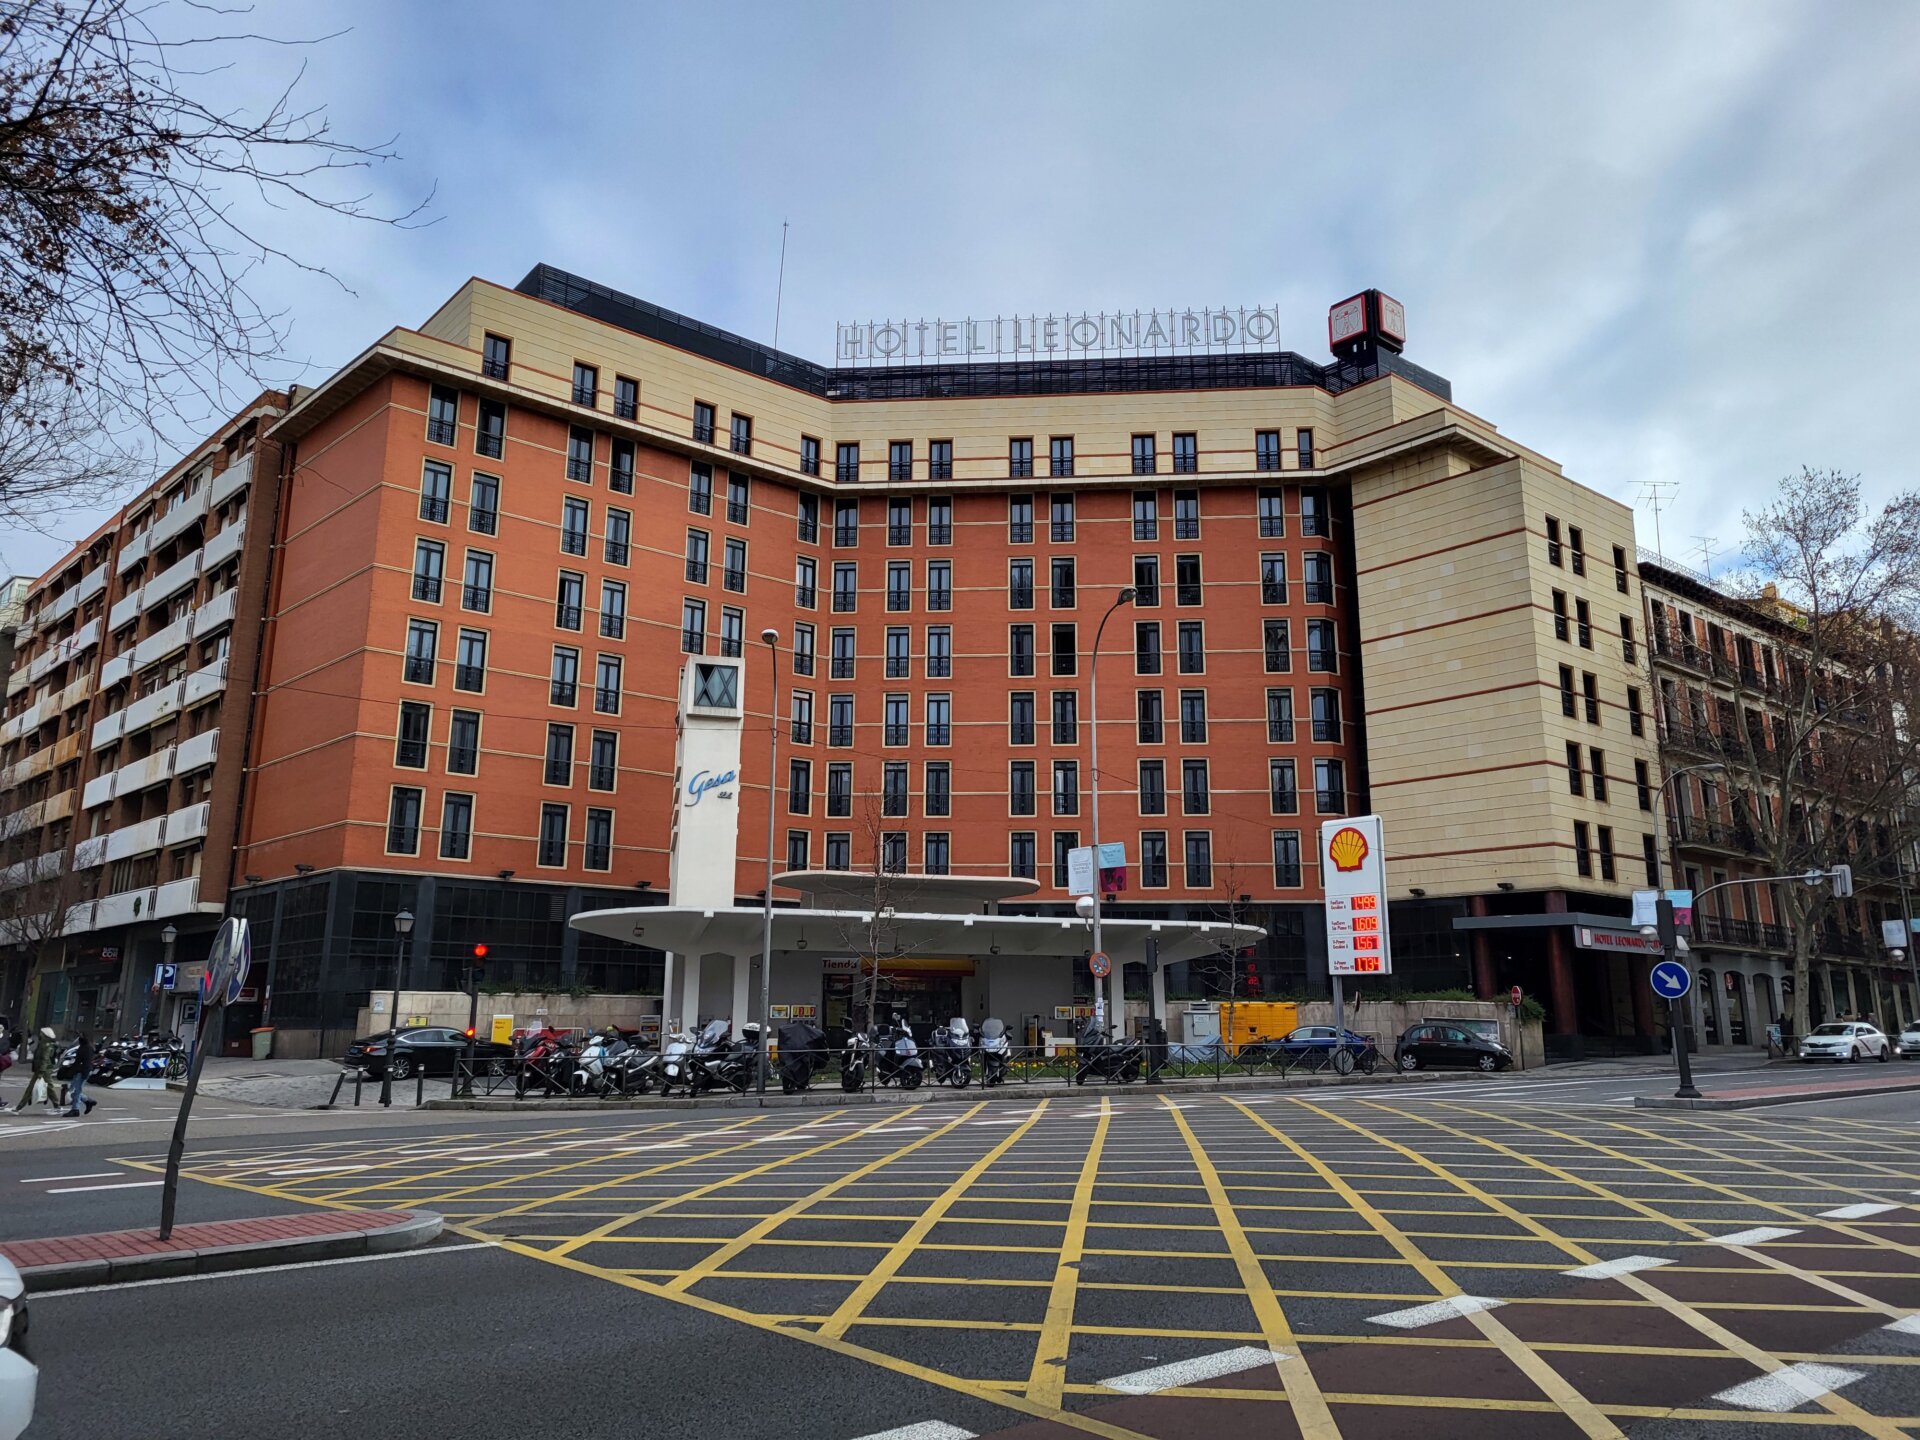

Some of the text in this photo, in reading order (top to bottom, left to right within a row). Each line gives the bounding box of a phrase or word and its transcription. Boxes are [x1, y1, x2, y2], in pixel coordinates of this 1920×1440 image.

[844, 311, 1277, 356] HOTEL LEONARDO
[822, 959, 857, 969] Tienda
